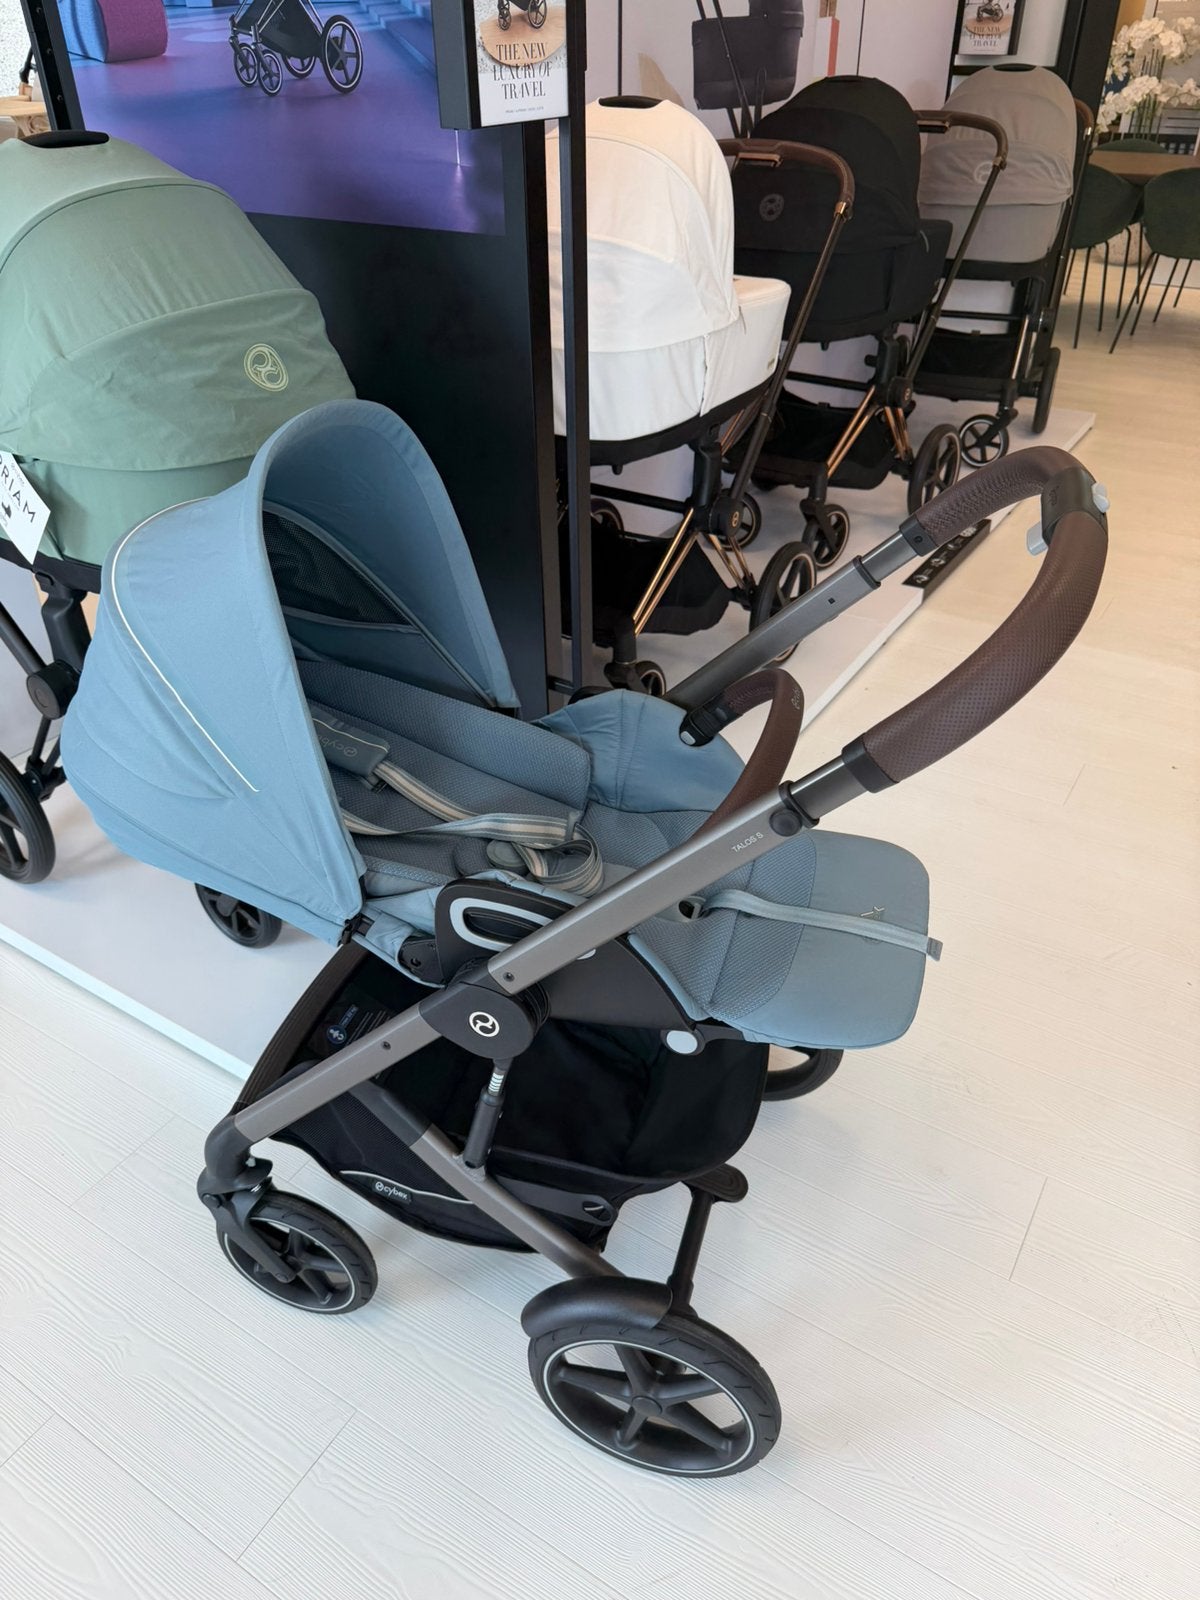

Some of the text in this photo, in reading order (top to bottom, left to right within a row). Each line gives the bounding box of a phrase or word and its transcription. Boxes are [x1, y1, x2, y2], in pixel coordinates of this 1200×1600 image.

[496, 42, 547, 61] THE NEW
[493, 61, 552, 81] LUXURY OF
[502, 81, 546, 100] TRAVEL
[731, 831, 764, 853] TALOS S
[384, 1186, 408, 1200] cybex
